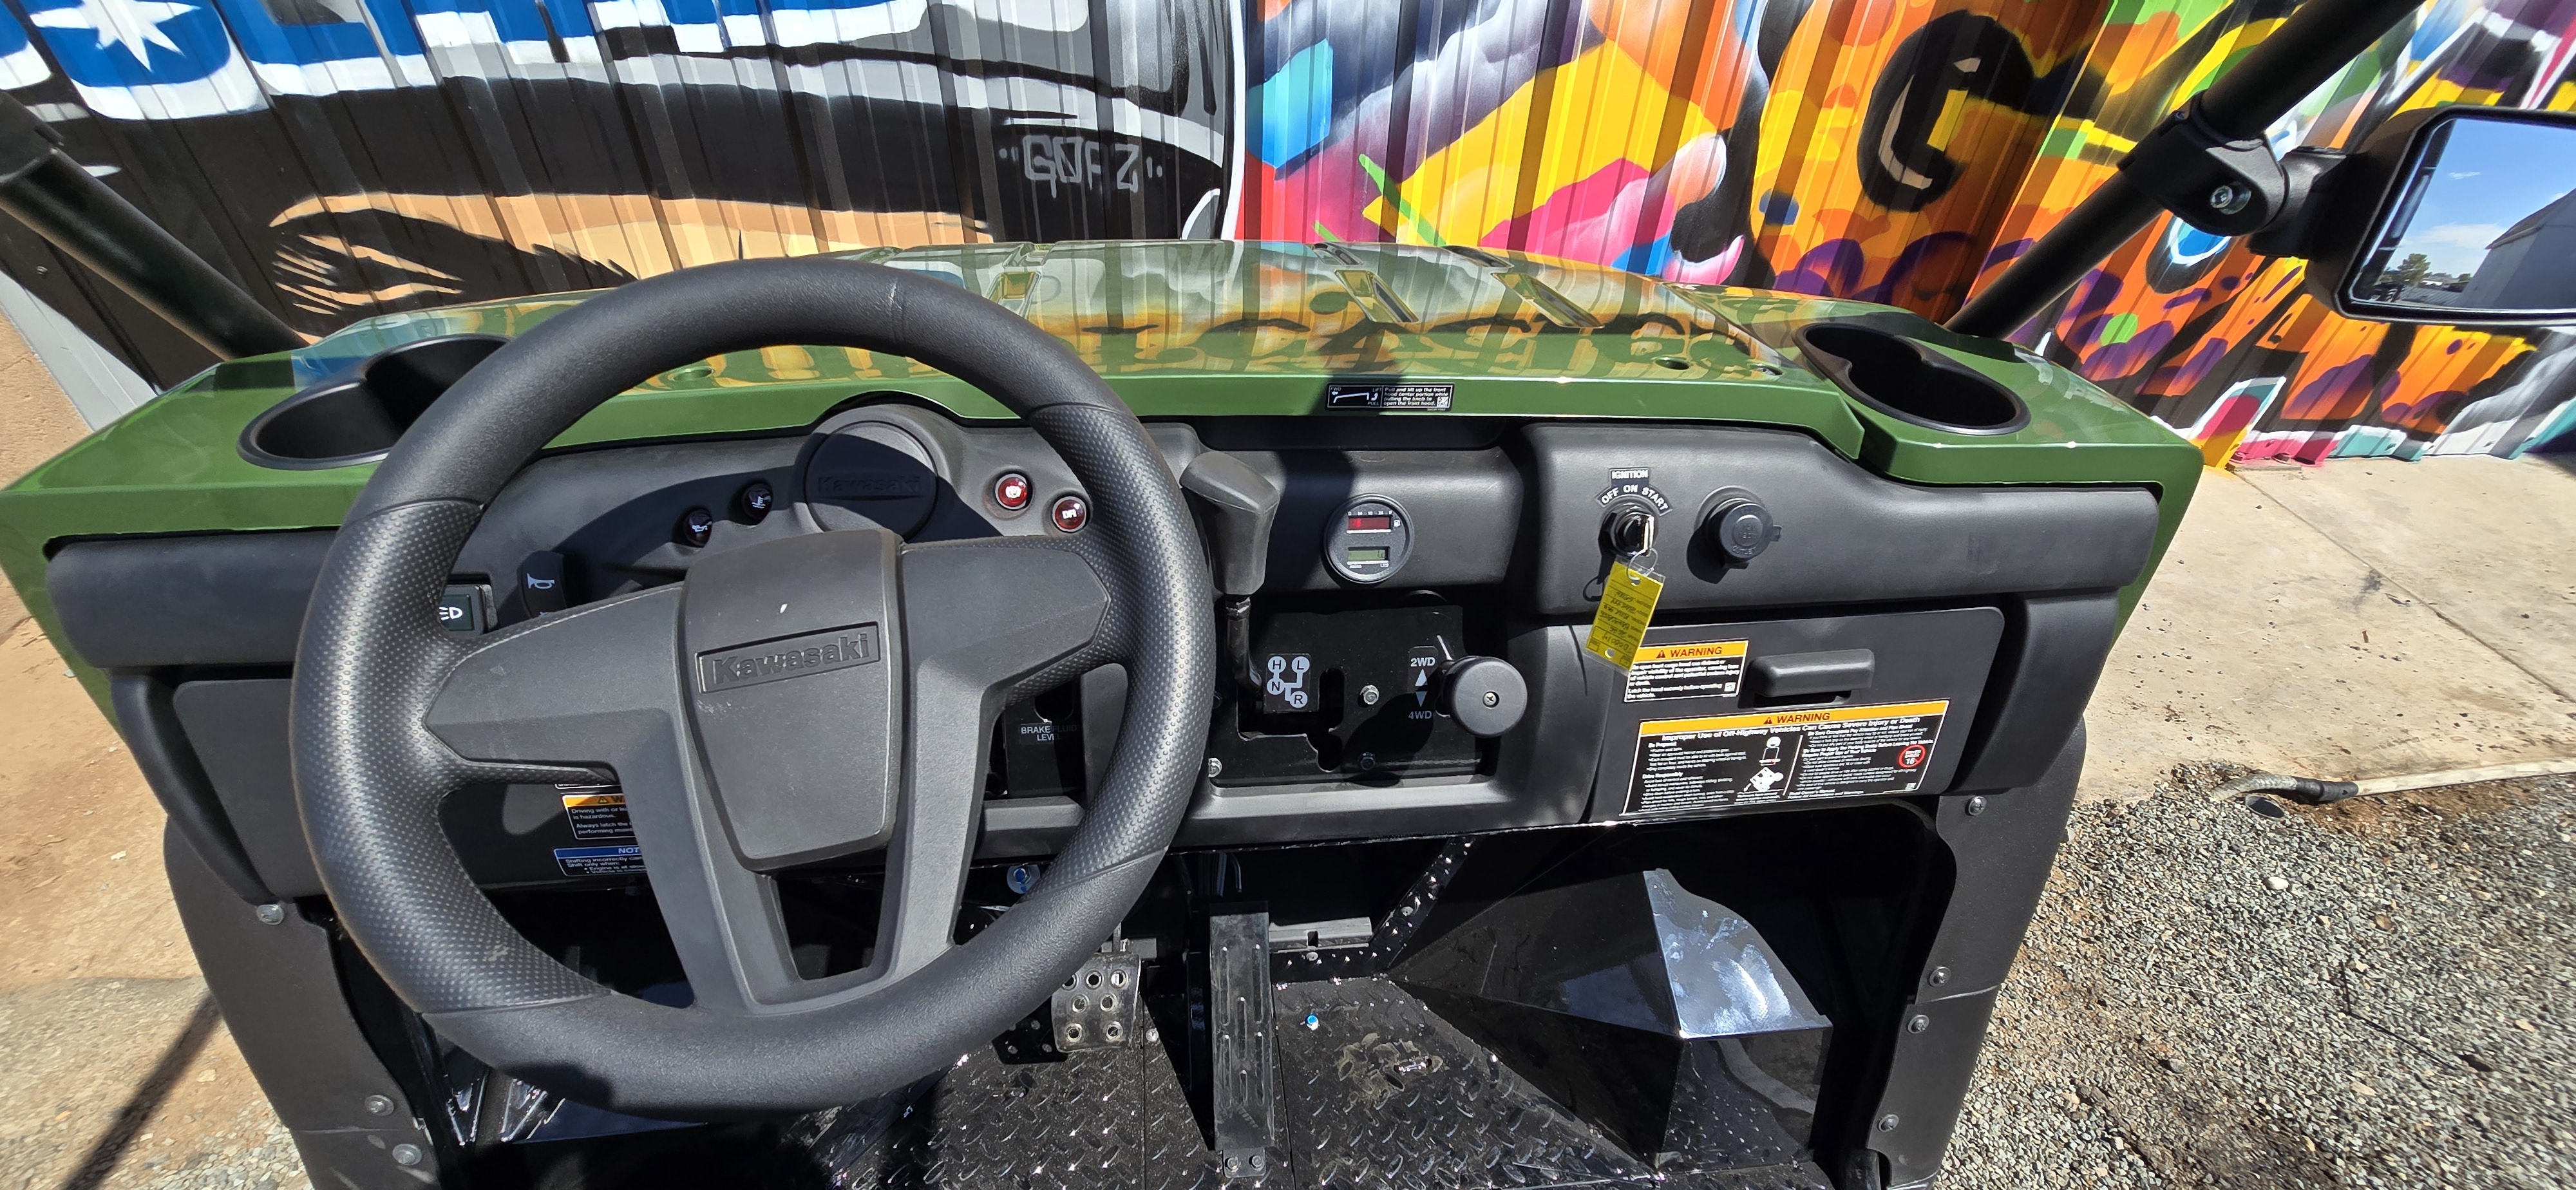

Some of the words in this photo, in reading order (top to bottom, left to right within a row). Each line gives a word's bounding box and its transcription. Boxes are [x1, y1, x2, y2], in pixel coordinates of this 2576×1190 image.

[1612, 470, 1648, 479] IGNITION
[819, 477, 921, 493] Kawasaki
[1602, 487, 1619, 504] OFF
[1642, 487, 1668, 510] START
[1670, 647, 1722, 657] WARNING
[712, 634, 869, 684] Kawasaki
[1410, 657, 1435, 667] 2WD
[1272, 660, 1282, 670] H
[1297, 660, 1304, 670] L
[1271, 681, 1280, 692] N
[1294, 695, 1303, 704] R
[1408, 711, 1432, 720] 4WD
[1777, 712, 1830, 724] WARNING
[1021, 726, 1051, 734] BRAKE
